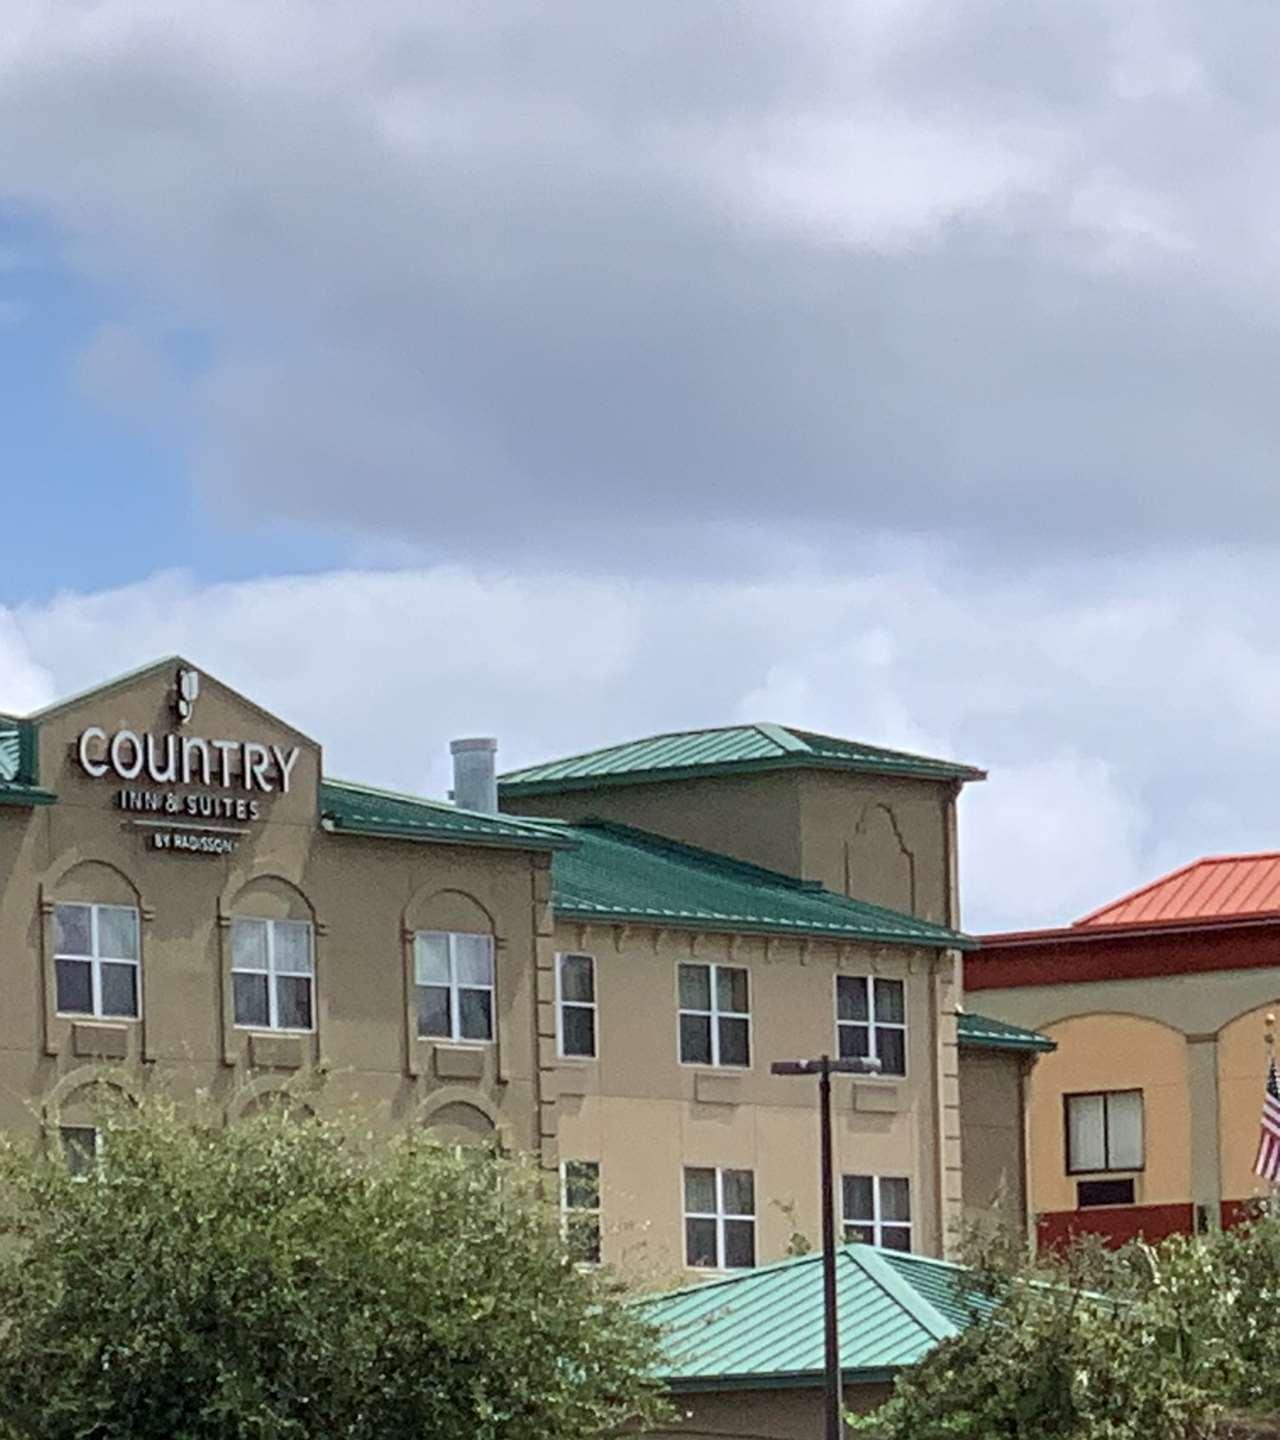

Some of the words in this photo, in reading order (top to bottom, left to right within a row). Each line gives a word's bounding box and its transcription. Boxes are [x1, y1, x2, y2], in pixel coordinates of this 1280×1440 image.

[120, 789, 158, 810] INN
[164, 792, 179, 813] &
[186, 795, 260, 820] SUITES
